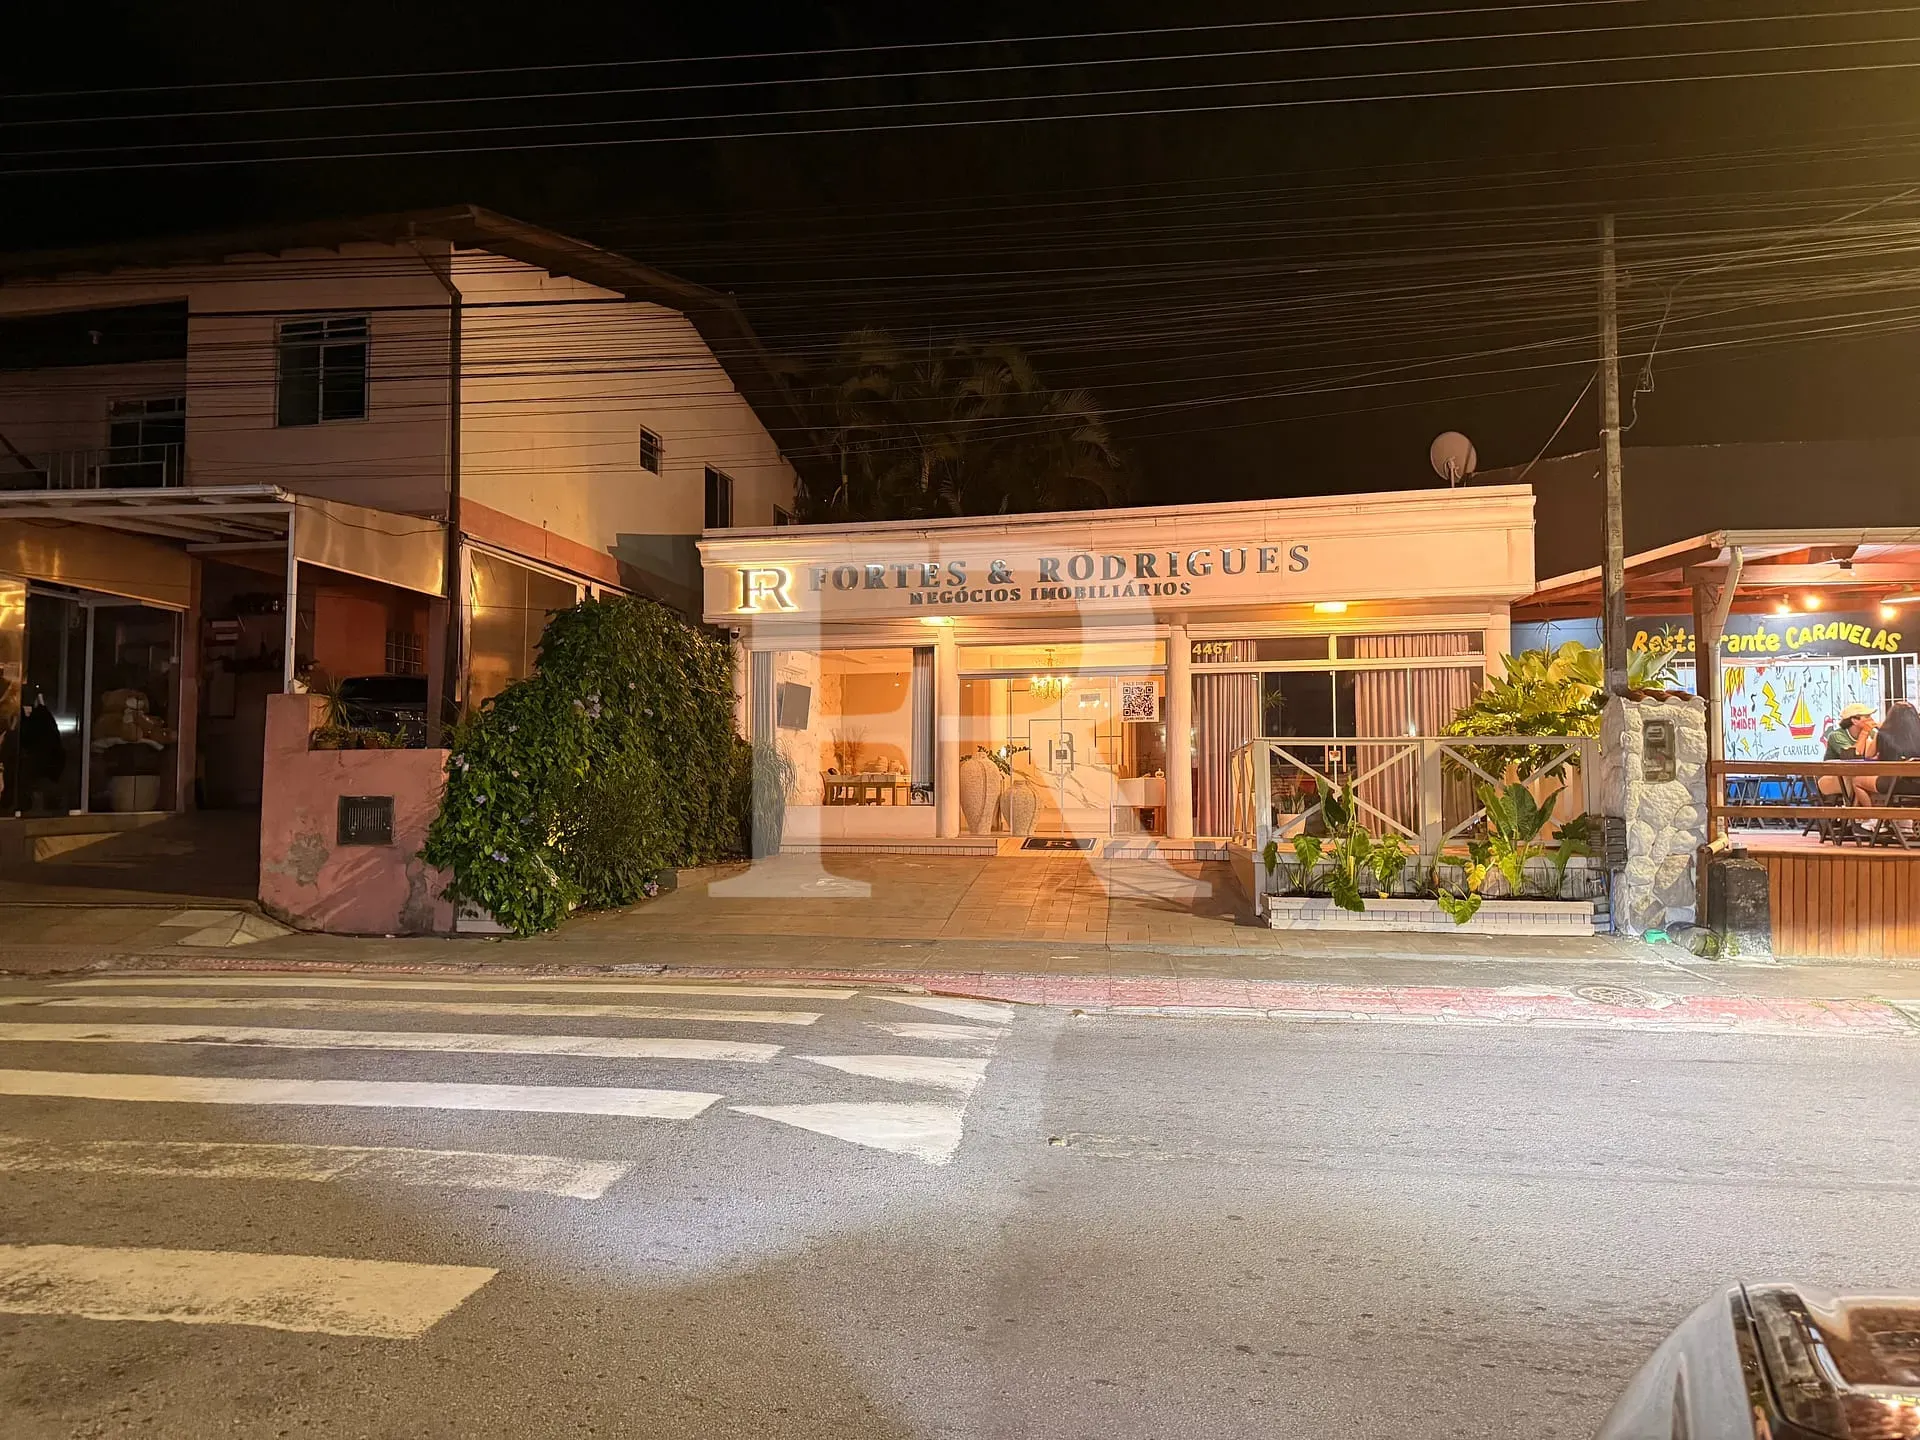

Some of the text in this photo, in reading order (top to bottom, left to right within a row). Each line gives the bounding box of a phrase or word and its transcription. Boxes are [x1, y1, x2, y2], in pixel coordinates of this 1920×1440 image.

[808, 544, 1310, 591] FORTES & RODRIGUES
[909, 580, 1192, 605] NEGÓCIOS IMOBILIÁRIOS
[1631, 621, 1902, 653] Restarante CARAVELAS
[1192, 642, 1233, 655] 4467
[1731, 705, 1748, 719] IRON
[1731, 717, 1757, 732] MAIDEN
[1782, 744, 1819, 757] CARAVELAS
